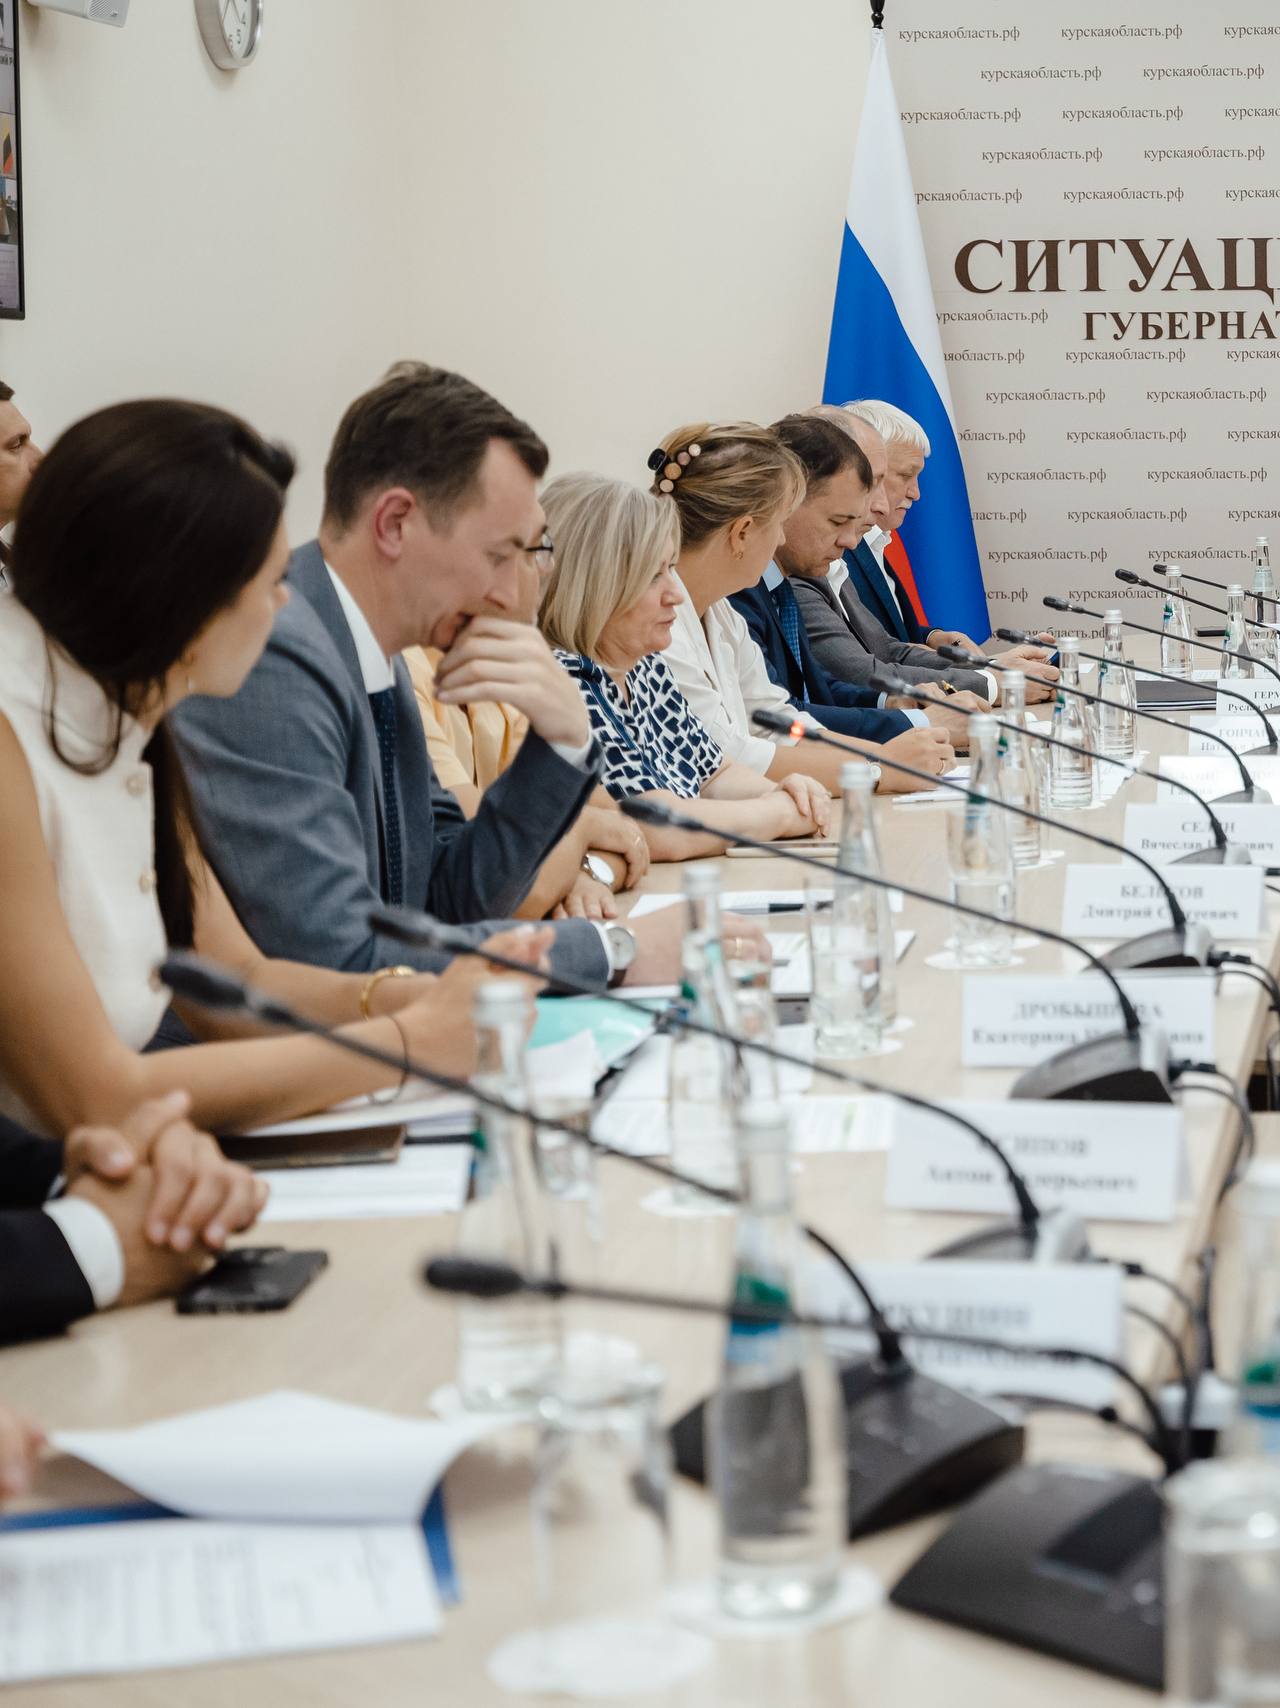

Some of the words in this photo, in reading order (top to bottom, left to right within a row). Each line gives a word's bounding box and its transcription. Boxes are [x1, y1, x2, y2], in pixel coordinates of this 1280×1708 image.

[898, 26, 1021, 42] курскаяобласть.рф
[1061, 24, 1183, 40] курскаяобласть.рф
[980, 66, 1102, 82] курскаяобласть.рф
[1143, 64, 1265, 80] курскаяобласть.рф
[900, 108, 1022, 124] курскаяобласть.рф
[1061, 106, 1184, 122] курскаяобласть.рф
[982, 147, 1103, 163] курскаяобласть.рф
[1143, 146, 1265, 162] курскаяобласть.рф
[914, 188, 1023, 205] рскаяобласть.рф
[1063, 187, 1185, 203] курскаяобласть.рф
[936, 308, 1049, 325] урскаяобласть.рф
[944, 348, 1025, 364] яобласть.рф
[1065, 348, 1186, 363] курскаяобласть.рф
[985, 388, 1106, 404] курскаяобласть.рф
[1144, 387, 1267, 403] курскаяобласть.рф
[1066, 428, 1187, 443] курскаяобласть.рф
[987, 468, 1107, 484] курскаяобласть.рф
[1147, 467, 1268, 483] курскаяобласть.рф
[1067, 507, 1188, 523] курскаяобласть.рф
[988, 548, 1108, 563] курскаяобласть.рф
